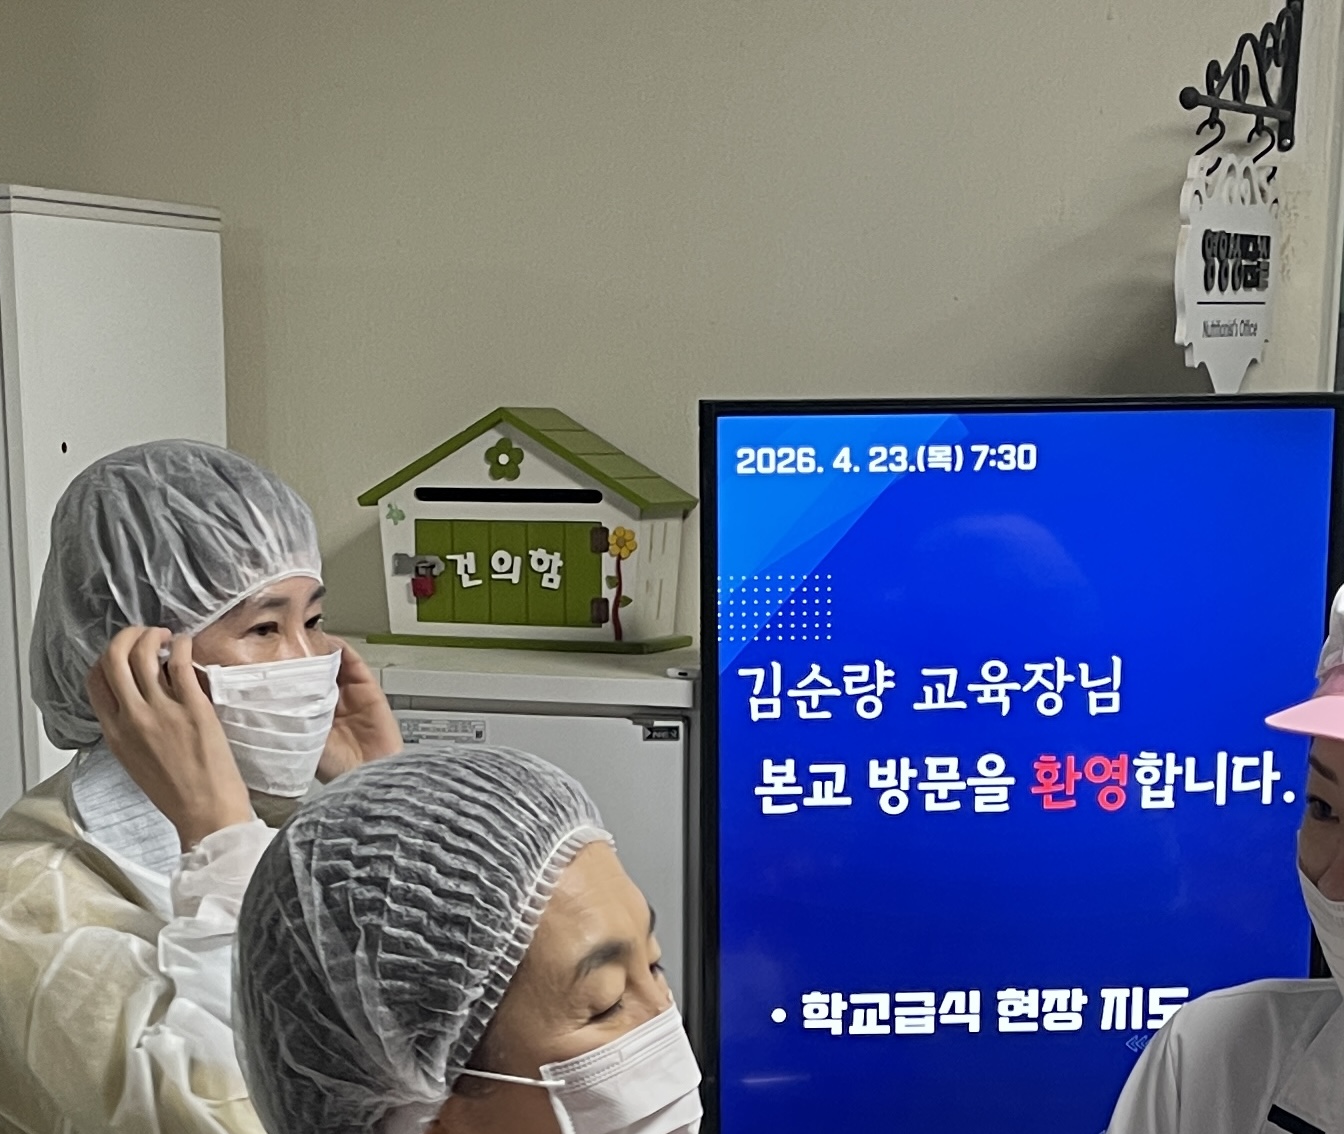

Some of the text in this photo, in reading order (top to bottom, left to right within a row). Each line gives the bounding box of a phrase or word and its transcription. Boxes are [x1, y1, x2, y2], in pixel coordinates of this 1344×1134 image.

[737, 443, 1037, 474] 2026. 4. 23.(목) 7:30
[446, 548, 564, 591] 건의함
[738, 655, 1123, 722] 김순량 교육장님
[754, 750, 1297, 815] 본교 방문을 환영합니다.
[801, 986, 1190, 1036] 학교급식 현장 지도
